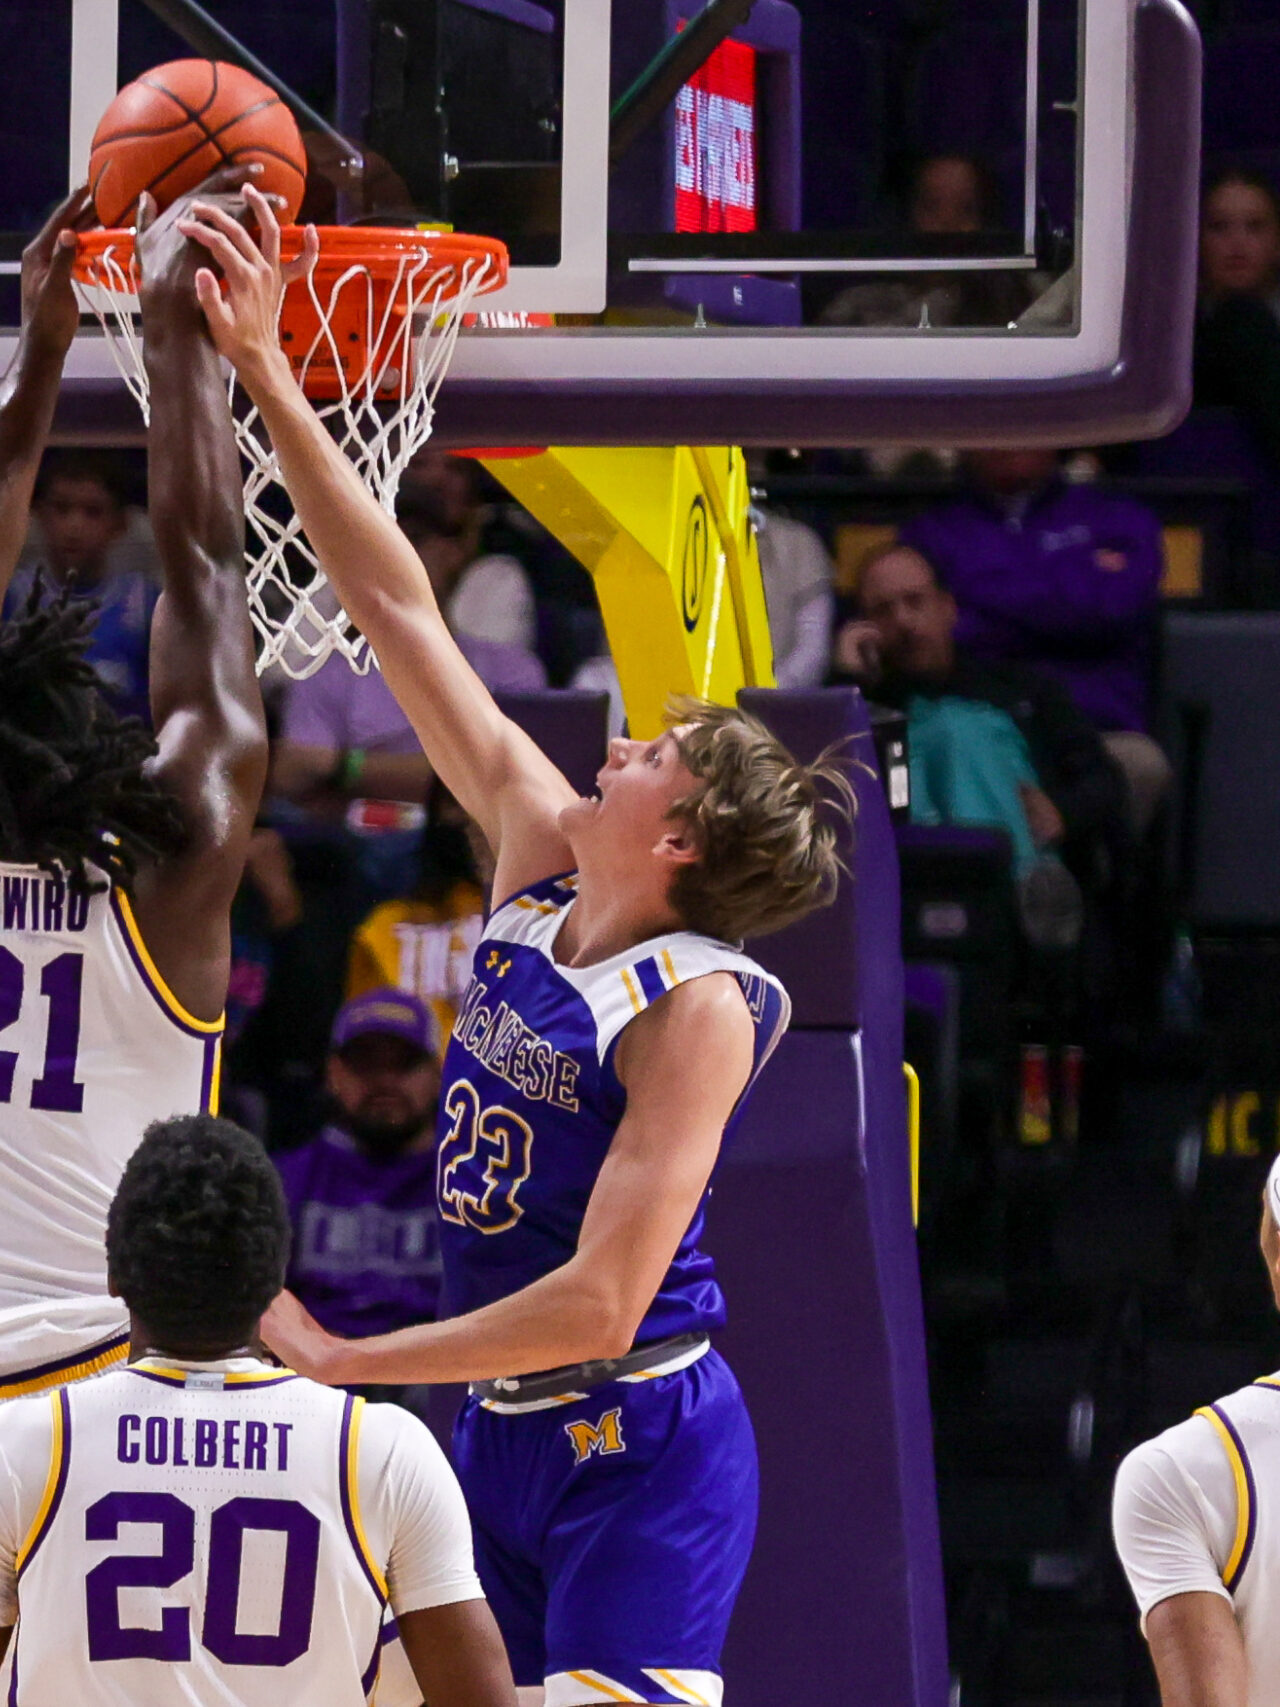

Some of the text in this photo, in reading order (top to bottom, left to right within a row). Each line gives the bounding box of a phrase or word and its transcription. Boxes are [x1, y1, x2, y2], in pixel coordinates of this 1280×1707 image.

[436, 1077, 535, 1236] 23
[117, 1414, 294, 1472] COLBERT
[564, 1406, 626, 1466] M
[85, 1491, 322, 1667] 20
